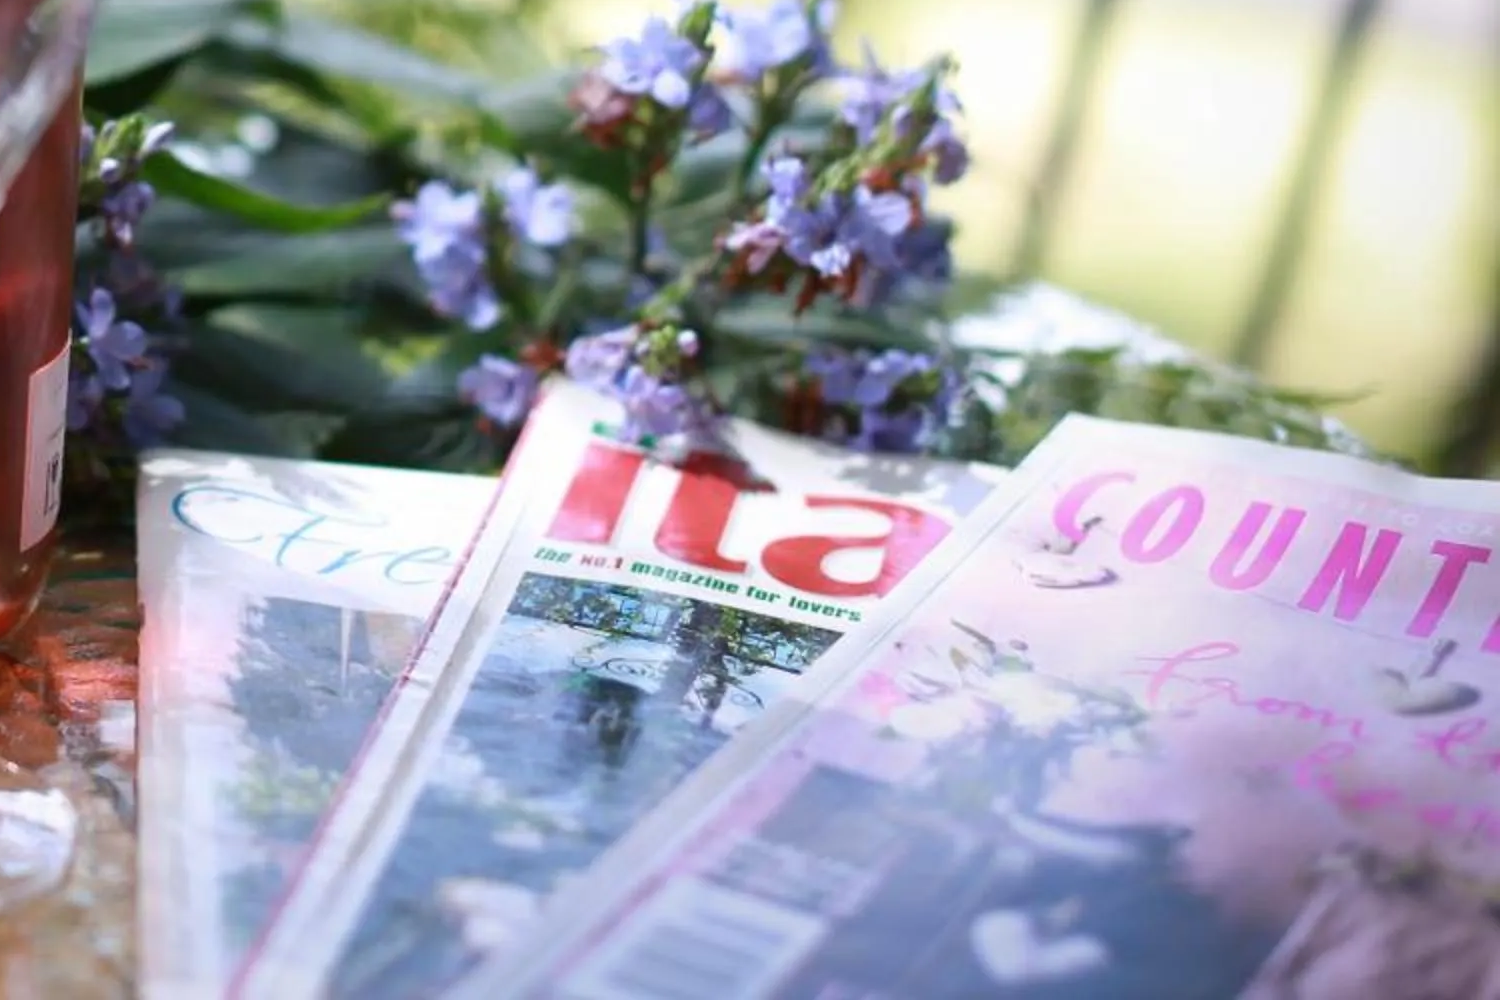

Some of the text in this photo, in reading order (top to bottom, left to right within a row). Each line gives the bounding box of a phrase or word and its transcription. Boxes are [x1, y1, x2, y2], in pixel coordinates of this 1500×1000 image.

[533, 546, 573, 565] the
[630, 560, 740, 597] magazine
[746, 585, 782, 605] for
[788, 596, 863, 623] lovers
[1052, 471, 1500, 654] COUNT
